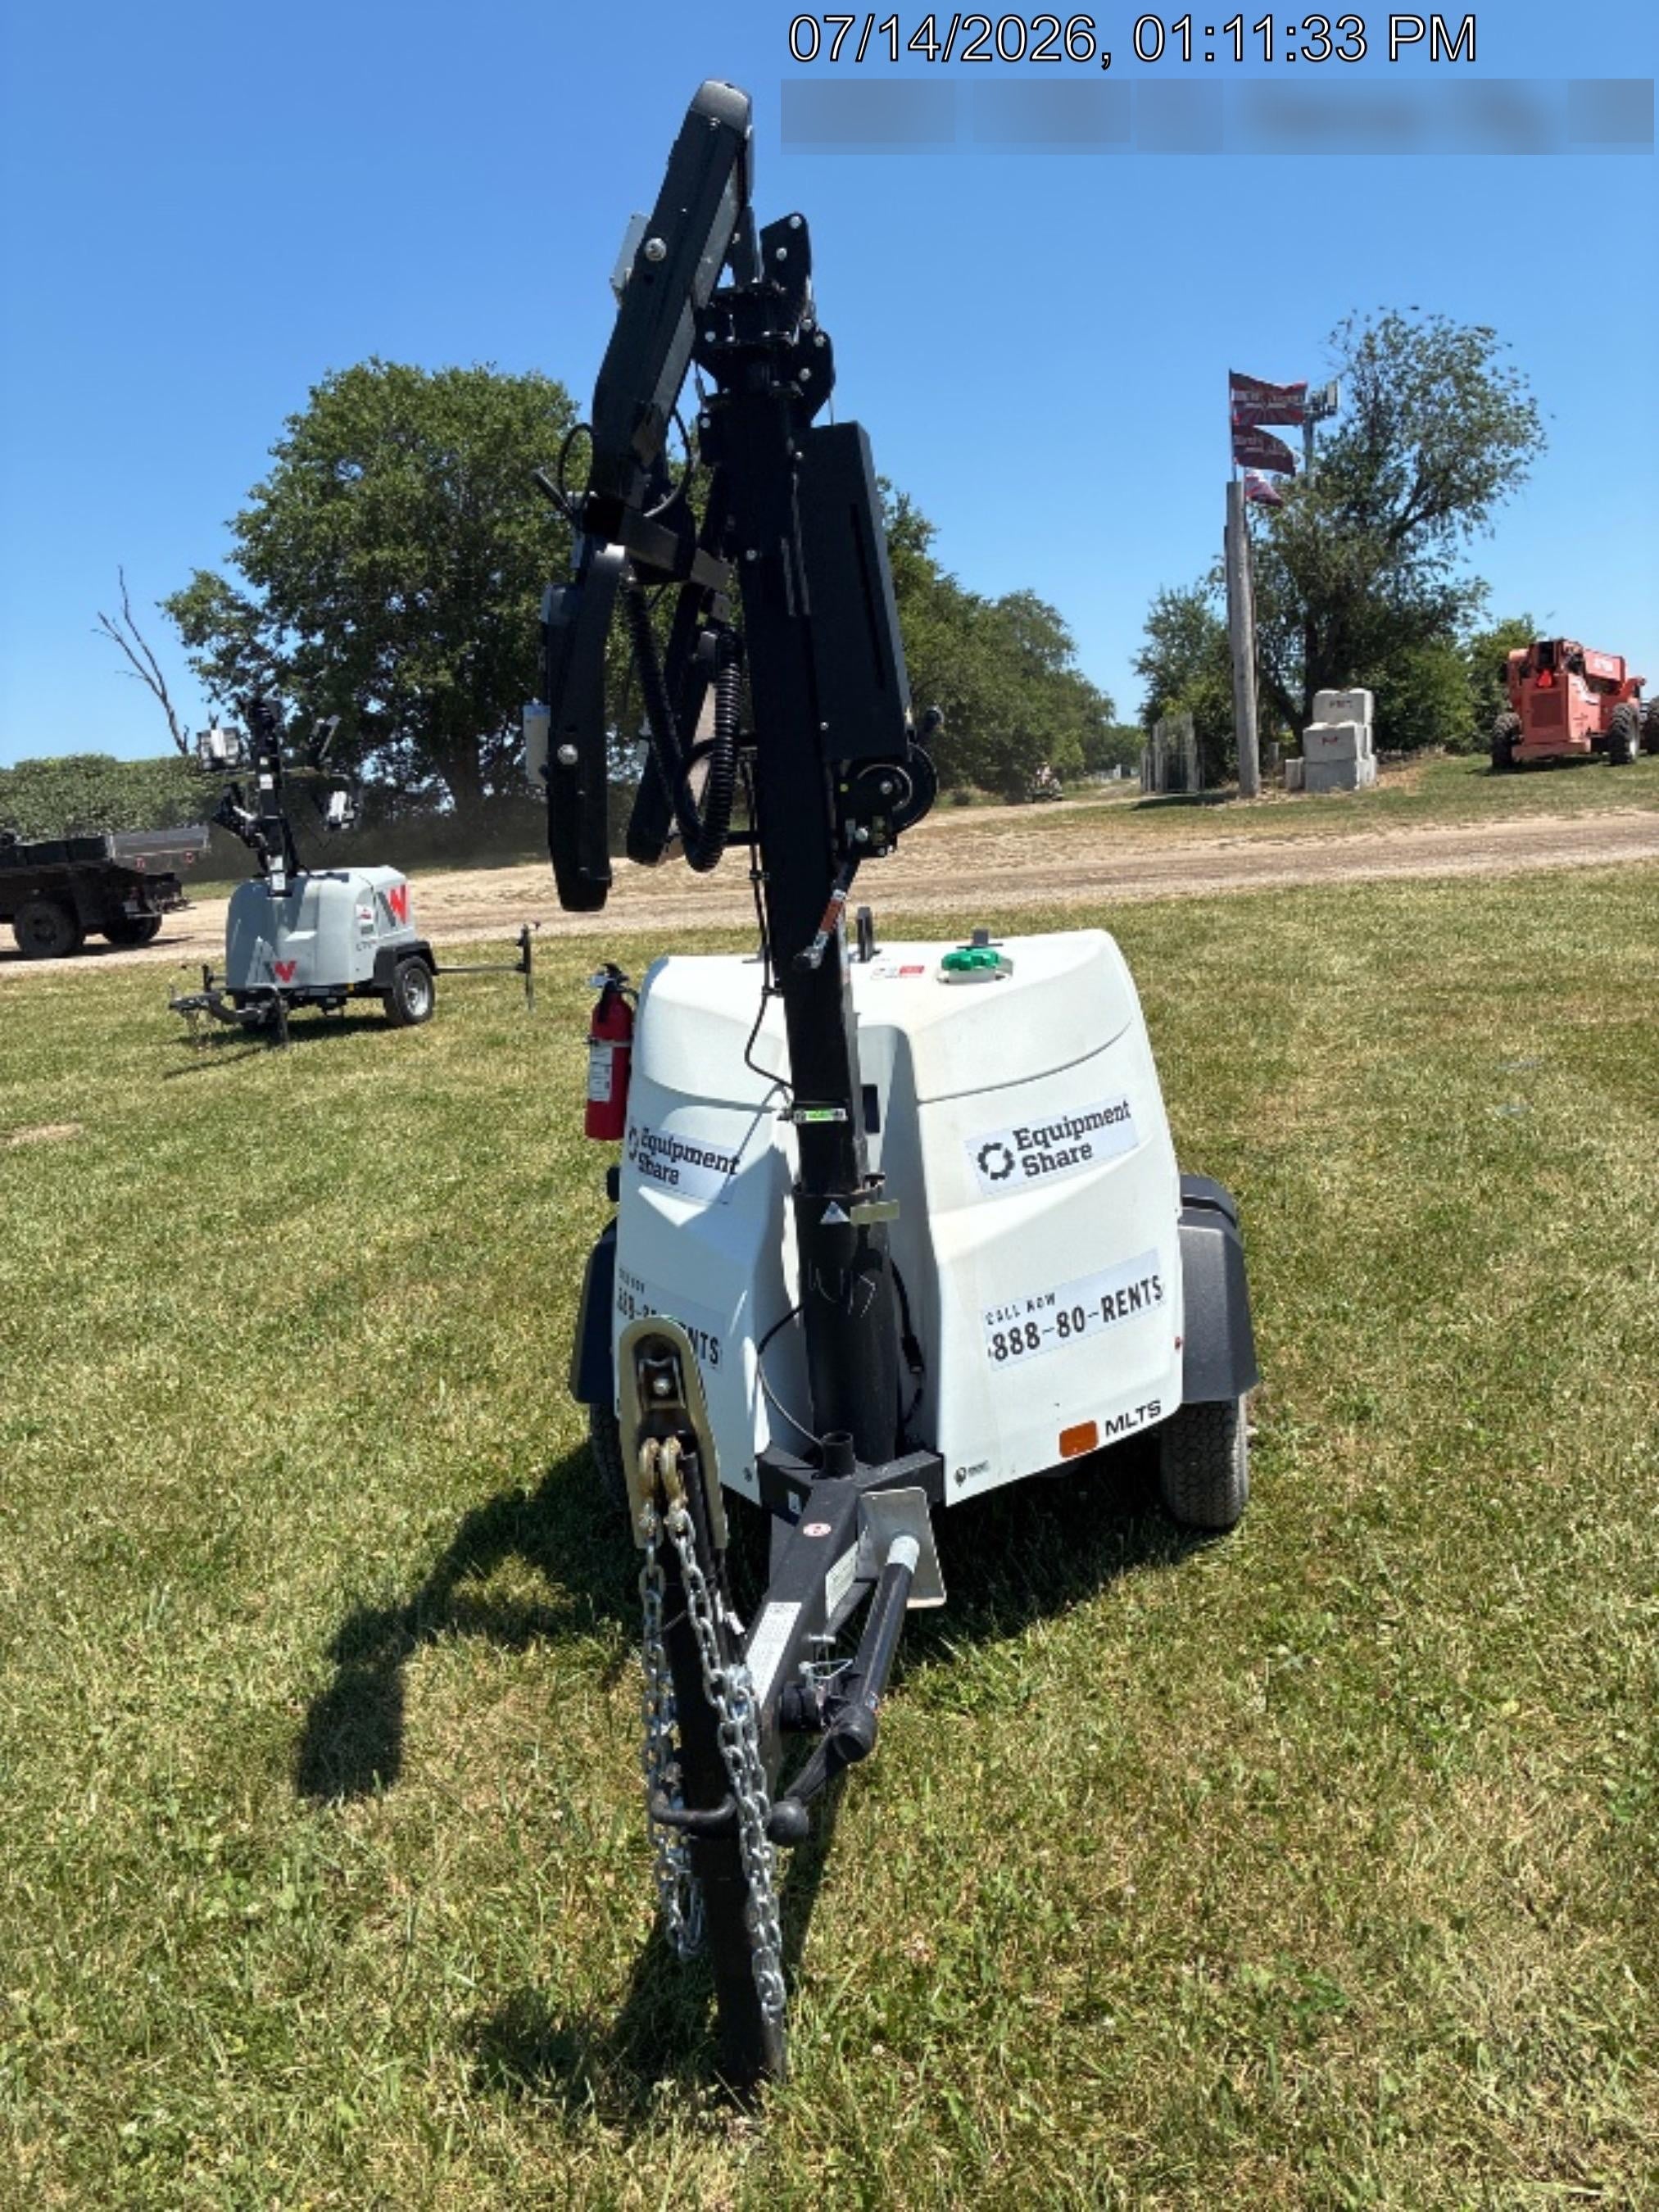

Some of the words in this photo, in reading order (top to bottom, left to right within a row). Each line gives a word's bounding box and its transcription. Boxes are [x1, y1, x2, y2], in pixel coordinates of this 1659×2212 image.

[1012, 1099, 1132, 1151] Equipment
[637, 1151, 679, 1185] Share
[640, 1126, 741, 1175] Equipment
[1021, 1142, 1094, 1178] Share
[1026, 1292, 1056, 1313] NOW
[1104, 1398, 1163, 1437] MLTS
